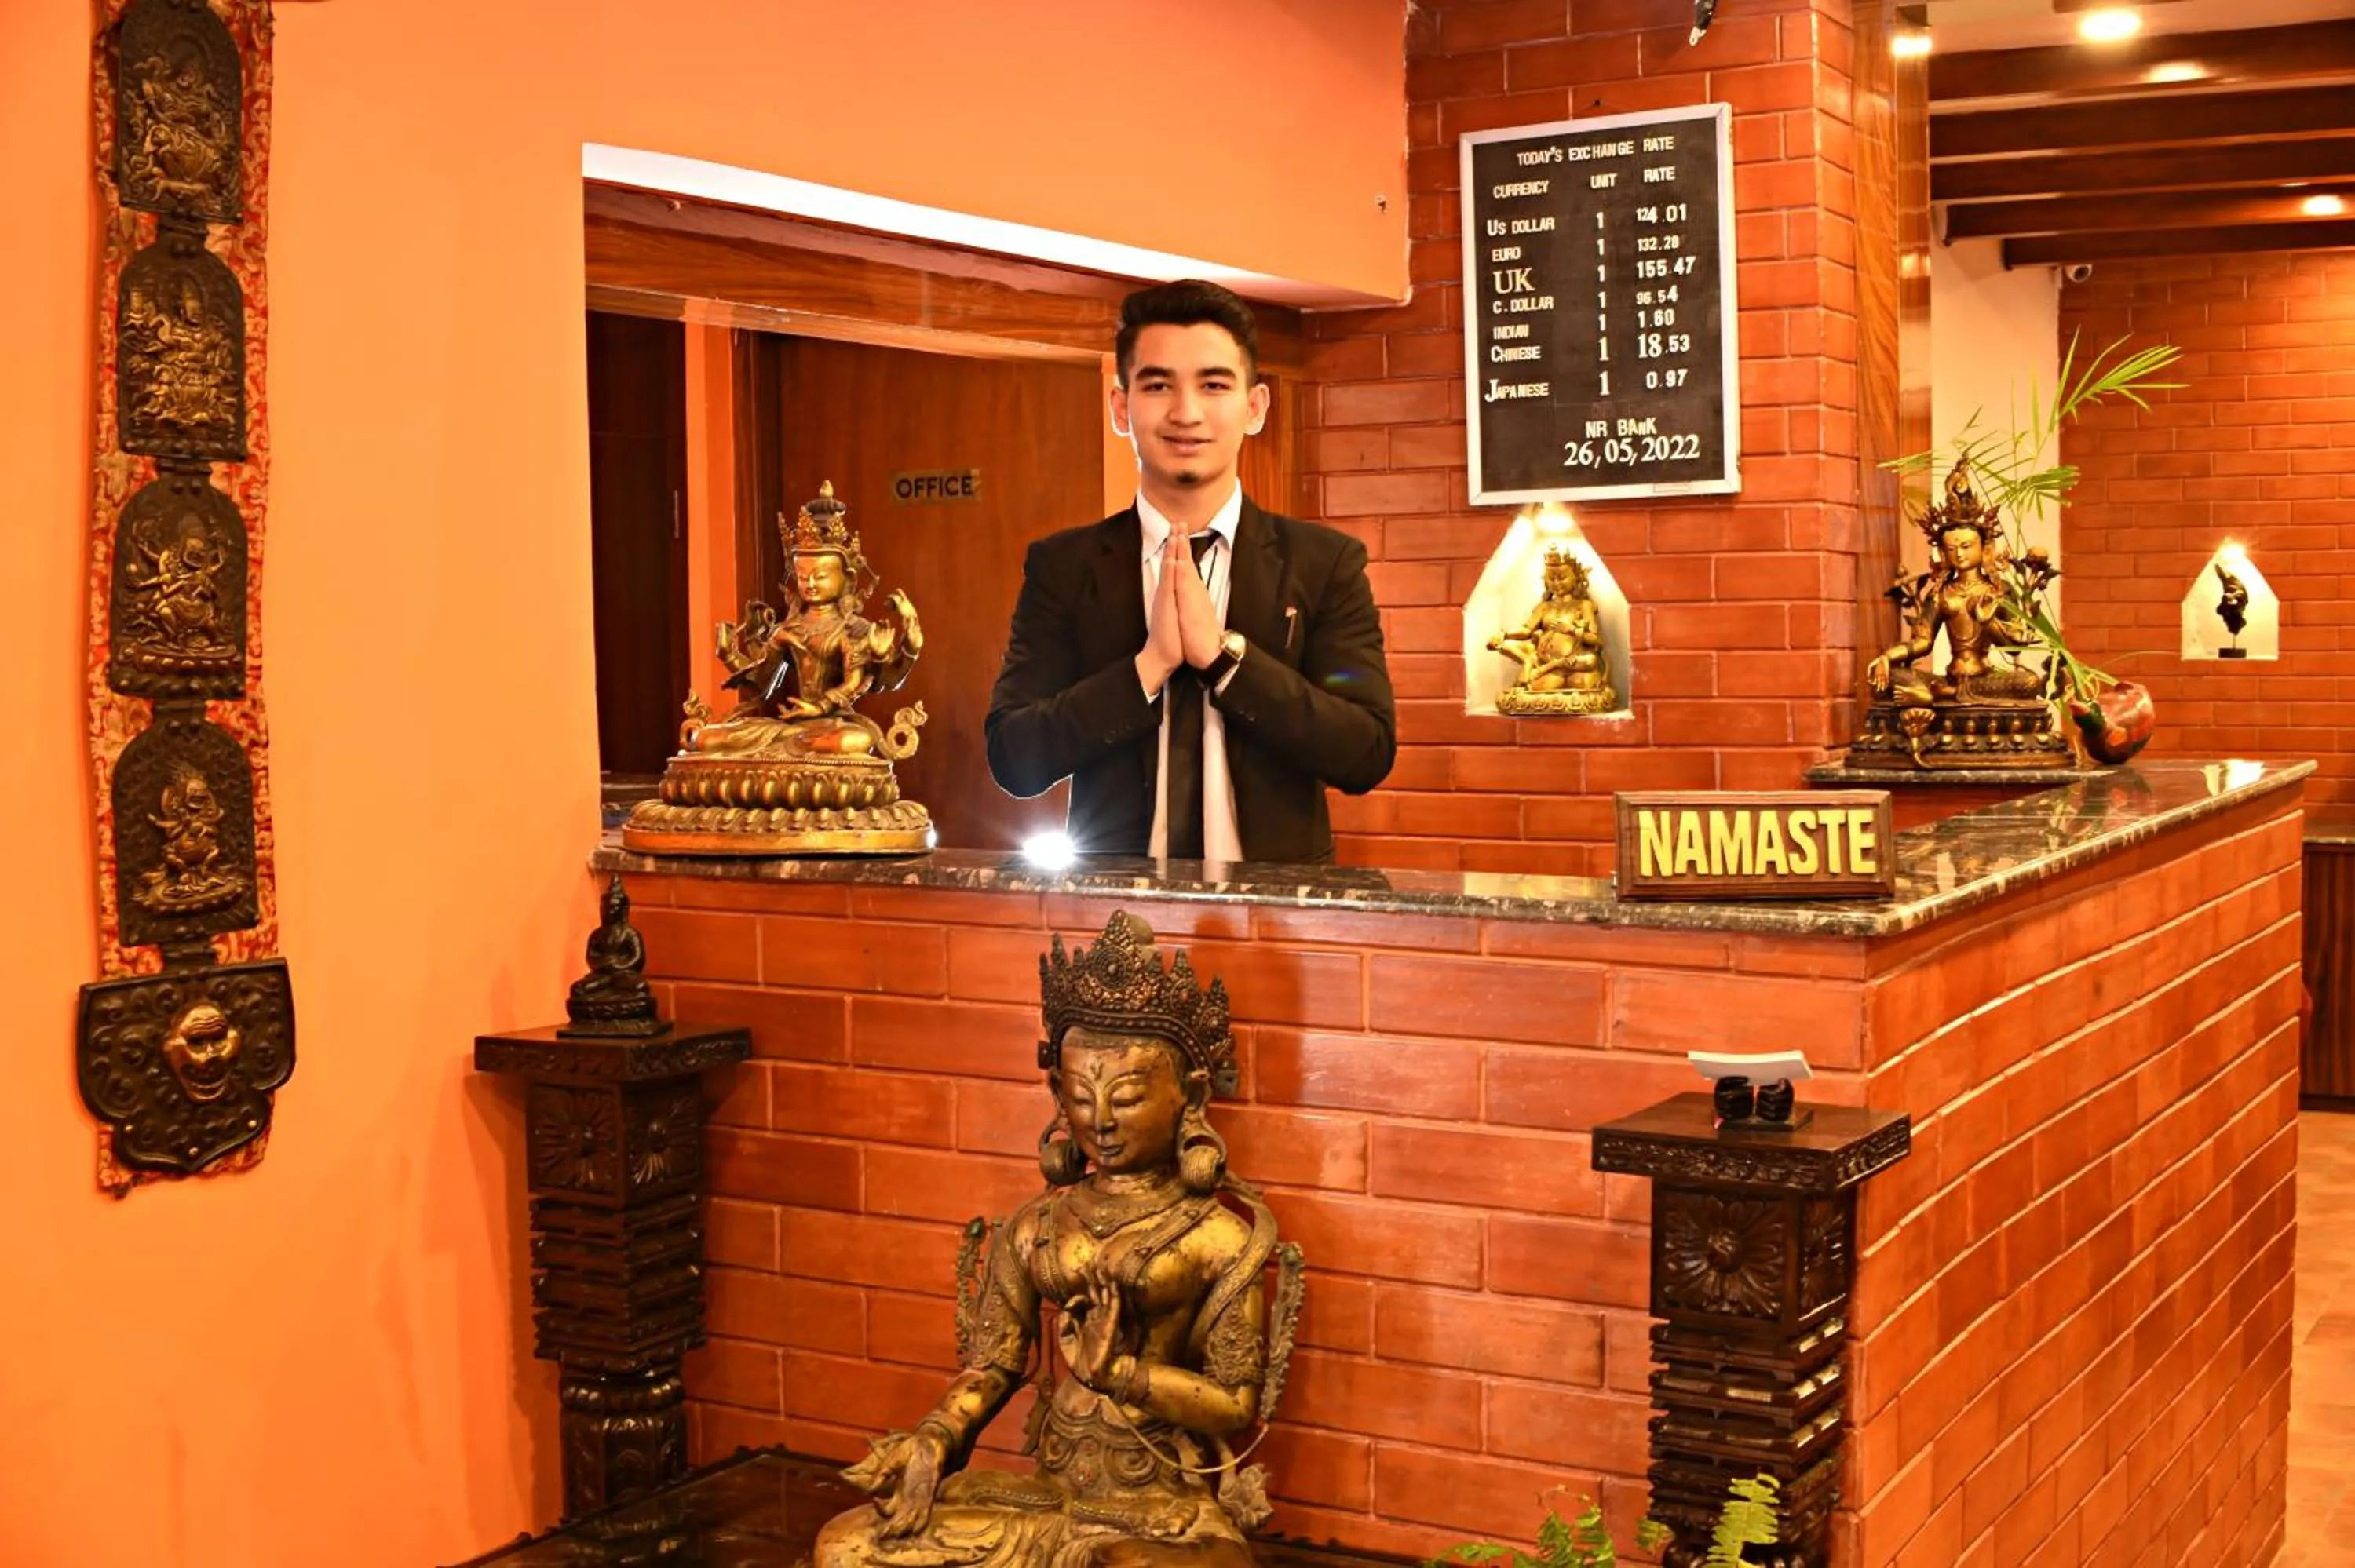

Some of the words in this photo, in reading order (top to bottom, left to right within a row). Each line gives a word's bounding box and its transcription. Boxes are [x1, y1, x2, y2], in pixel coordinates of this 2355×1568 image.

[1517, 146, 1563, 166] TODAY'S
[1568, 140, 1634, 162] EXCHANGE
[1643, 136, 1674, 152] RATE
[1493, 180, 1550, 199] CURRENCY
[1590, 173, 1618, 189] UNIT
[1643, 166, 1676, 183] RATE
[1511, 217, 1555, 235] DOLLAR
[1596, 211, 1604, 229] 1
[1636, 203, 1687, 224] 124.01
[1492, 246, 1521, 262] EURO
[1597, 238, 1605, 256] 1
[1637, 235, 1680, 252] 132.28
[1492, 268, 1535, 294] UK
[1597, 264, 1606, 283] 1
[1636, 255, 1696, 279] 155.47
[1510, 295, 1554, 312] DOLLAR
[1597, 291, 1606, 308] 1
[1636, 284, 1678, 305] 96.54
[1492, 324, 1529, 340] INDIAN
[1598, 313, 1606, 332] 1
[1637, 308, 1675, 329] 1.60
[1491, 345, 1541, 363] CHINESE
[1598, 336, 1609, 361] 1
[1638, 333, 1690, 359] 18.53
[1484, 378, 1550, 403] JAPANESE
[1599, 370, 1610, 396] 1
[1645, 368, 1689, 389] 0.97
[1585, 420, 1608, 439] NR
[896, 476, 973, 498] OFFICE
[1638, 808, 1876, 877] NAMASTE
